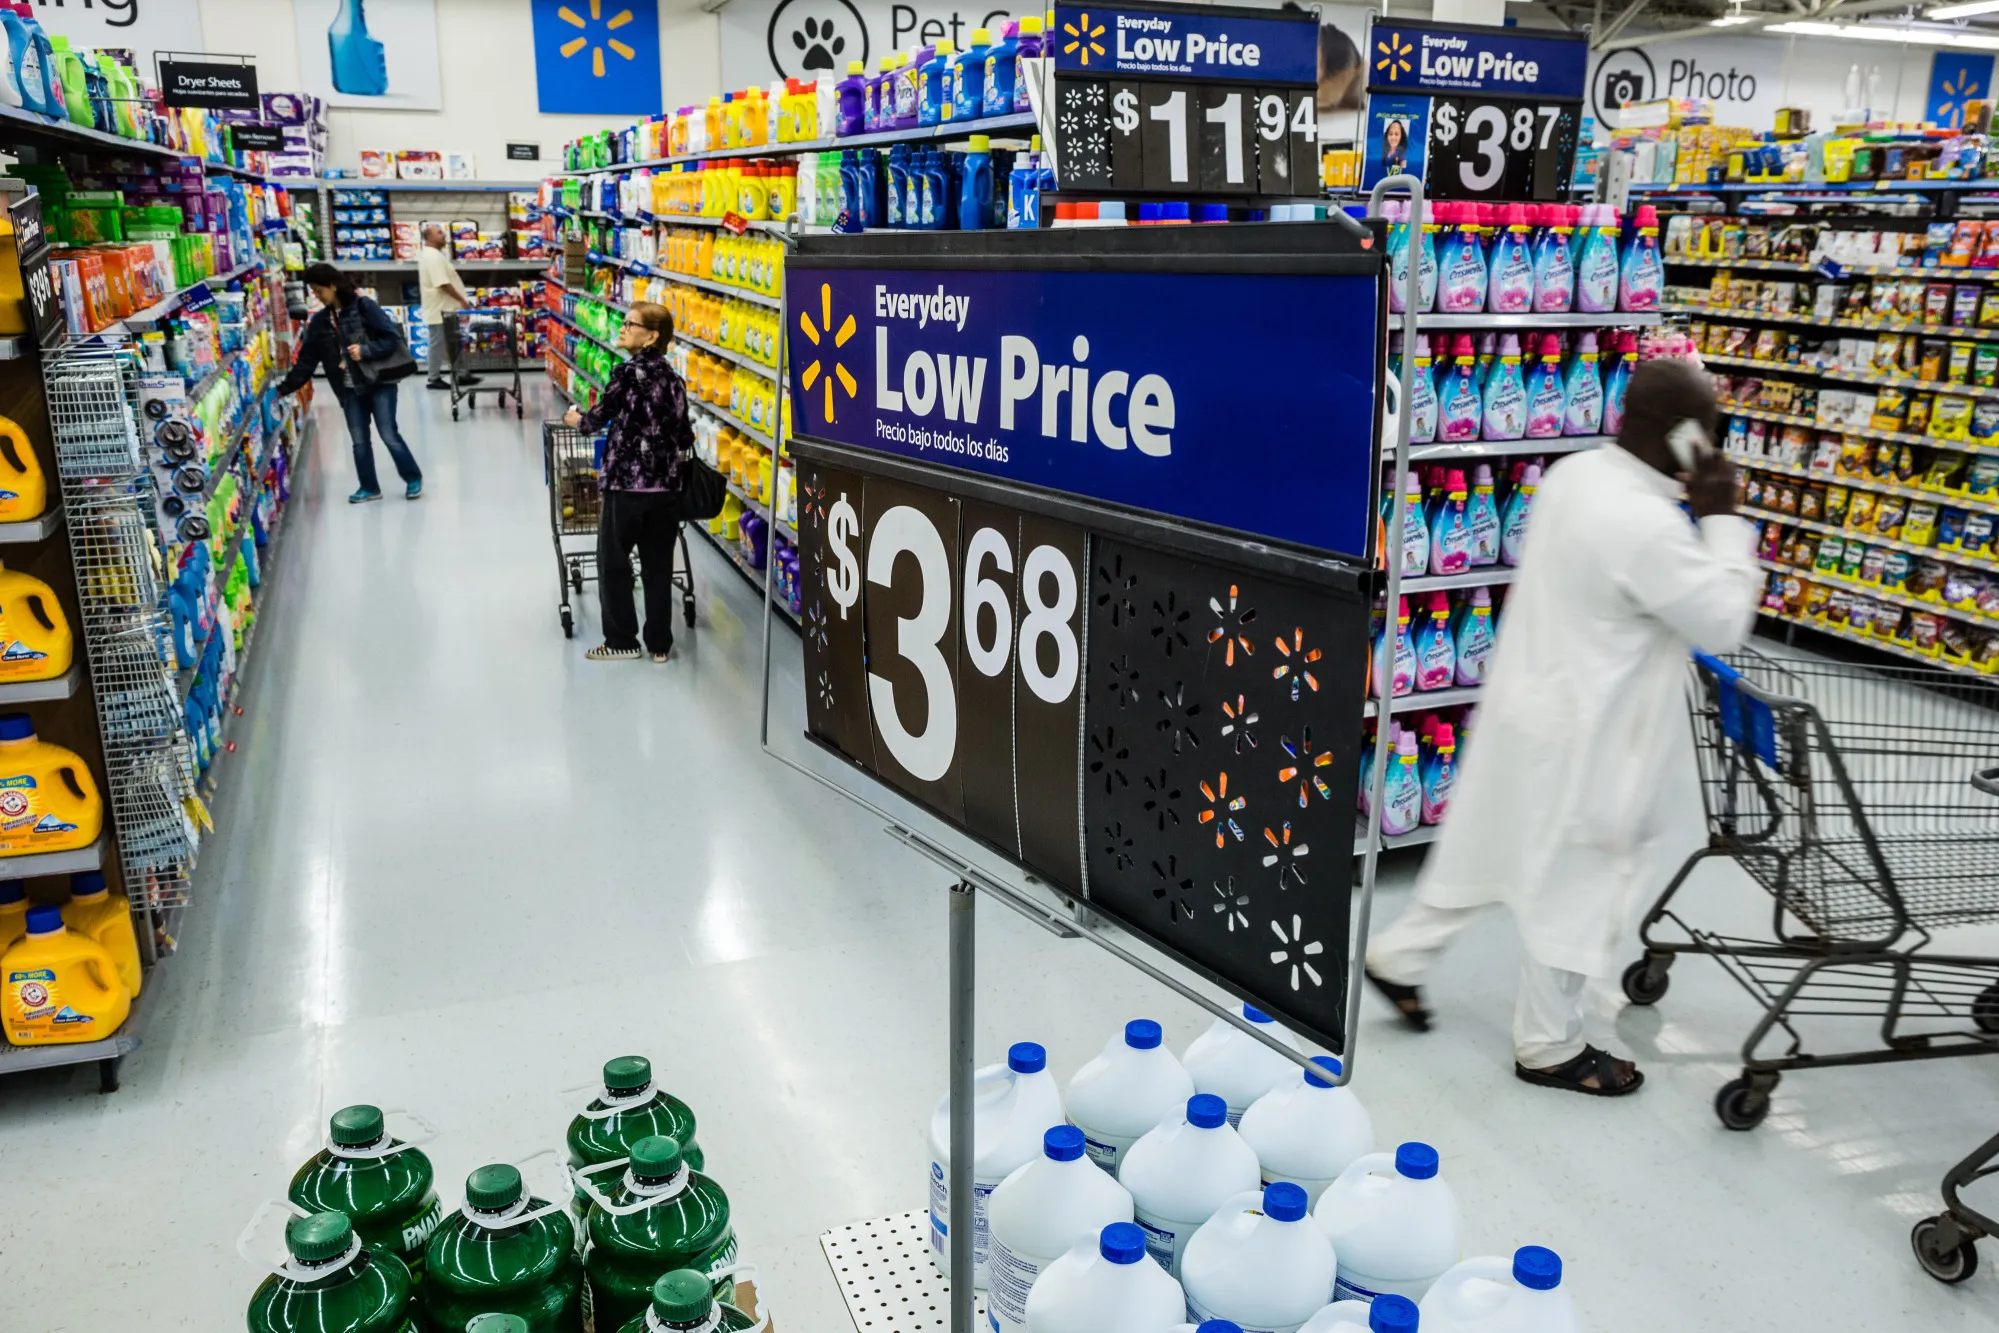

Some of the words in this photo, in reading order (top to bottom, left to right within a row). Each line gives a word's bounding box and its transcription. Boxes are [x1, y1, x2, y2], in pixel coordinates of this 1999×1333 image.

[892, 4, 965, 52] Pet
[1117, 15, 1172, 33] Everyday
[1422, 34, 1468, 52] Everyday
[1116, 29, 1181, 62] Low
[1186, 33, 1261, 67] Price
[1116, 60, 1136, 70] Precio
[1136, 61, 1151, 72] bajo
[1151, 63, 1169, 72] todos
[1169, 63, 1179, 72] los
[1420, 47, 1474, 79] Low
[1477, 51, 1539, 84] Price
[178, 75, 206, 88] Dryer
[207, 76, 242, 89] Sheets
[1667, 58, 1757, 103] Photo
[875, 284, 970, 332] Everyday
[875, 325, 987, 424] Low
[1000, 334, 1176, 457] Price
[876, 418, 906, 443] Precio
[908, 423, 932, 451] bajo
[933, 430, 965, 454] todos
[967, 433, 983, 458] los
[985, 437, 1009, 463] días
